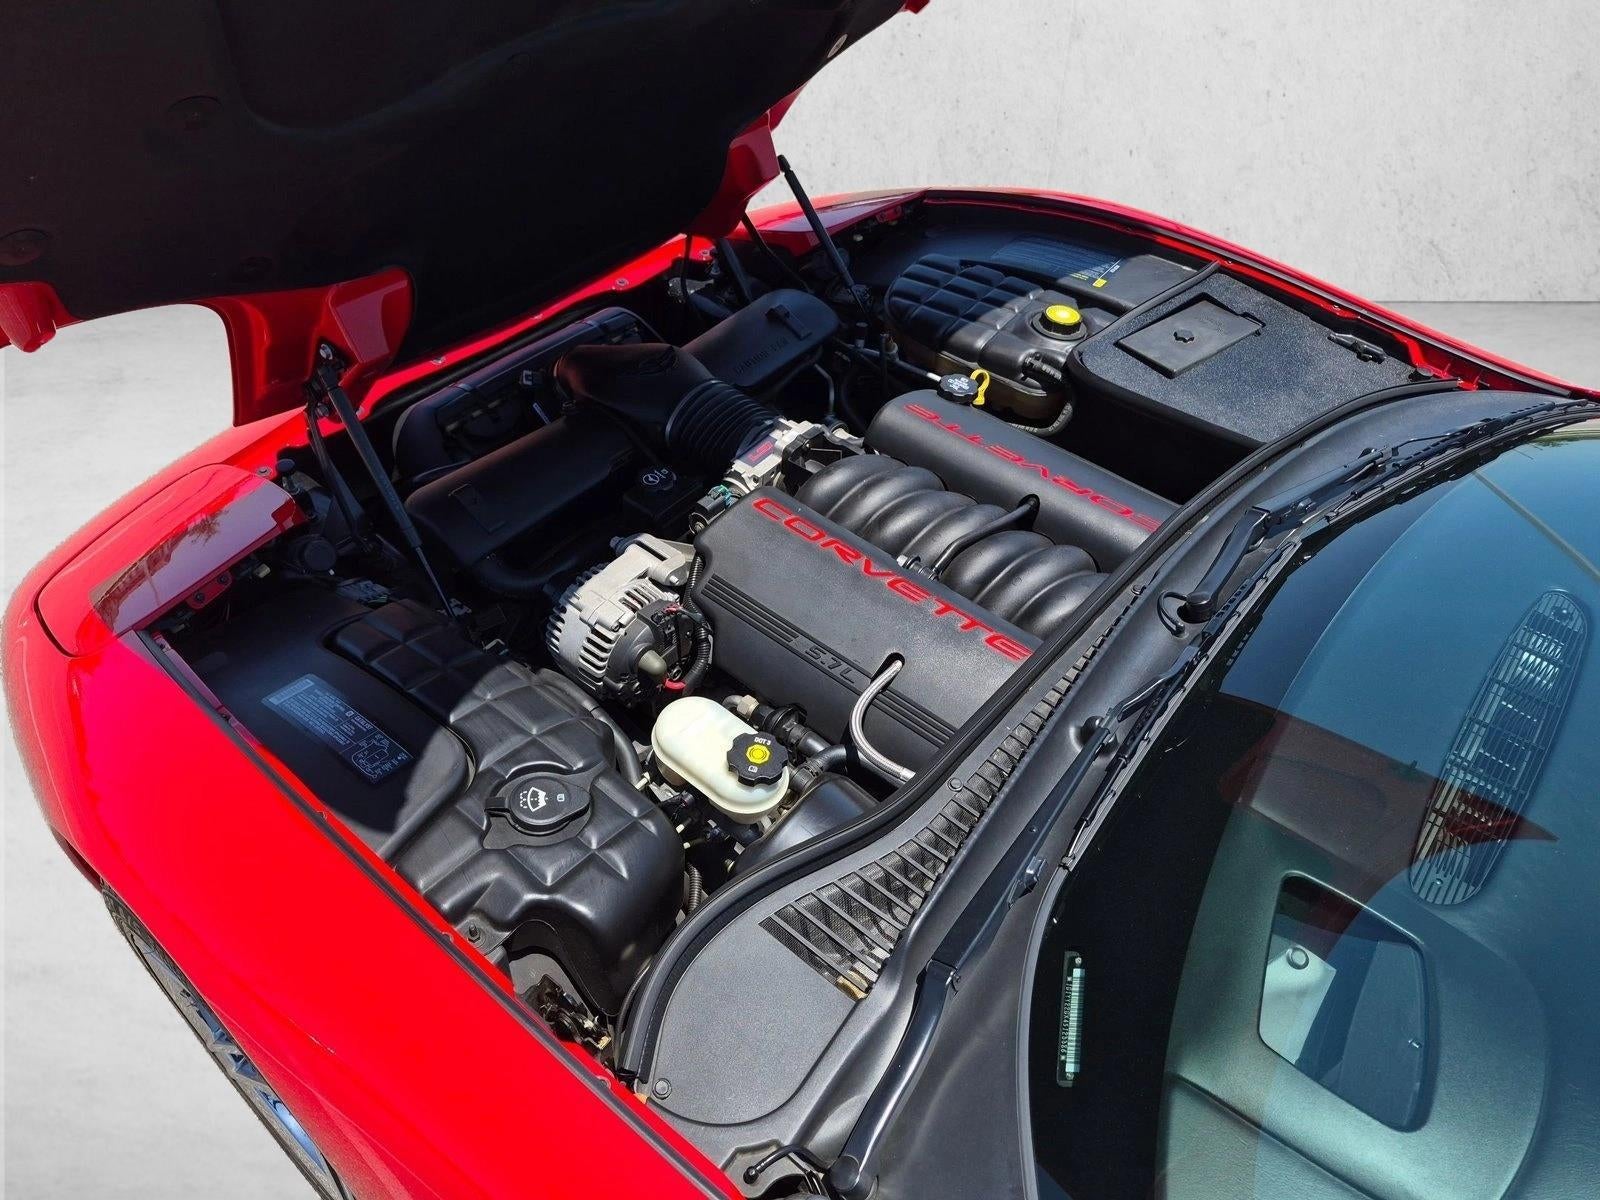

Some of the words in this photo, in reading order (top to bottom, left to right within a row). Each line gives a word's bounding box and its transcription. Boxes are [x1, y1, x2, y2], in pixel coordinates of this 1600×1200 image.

[752, 497, 1033, 662] CORVETTE
[804, 645, 855, 684] 5.7L
[754, 736, 767, 745] DOT
